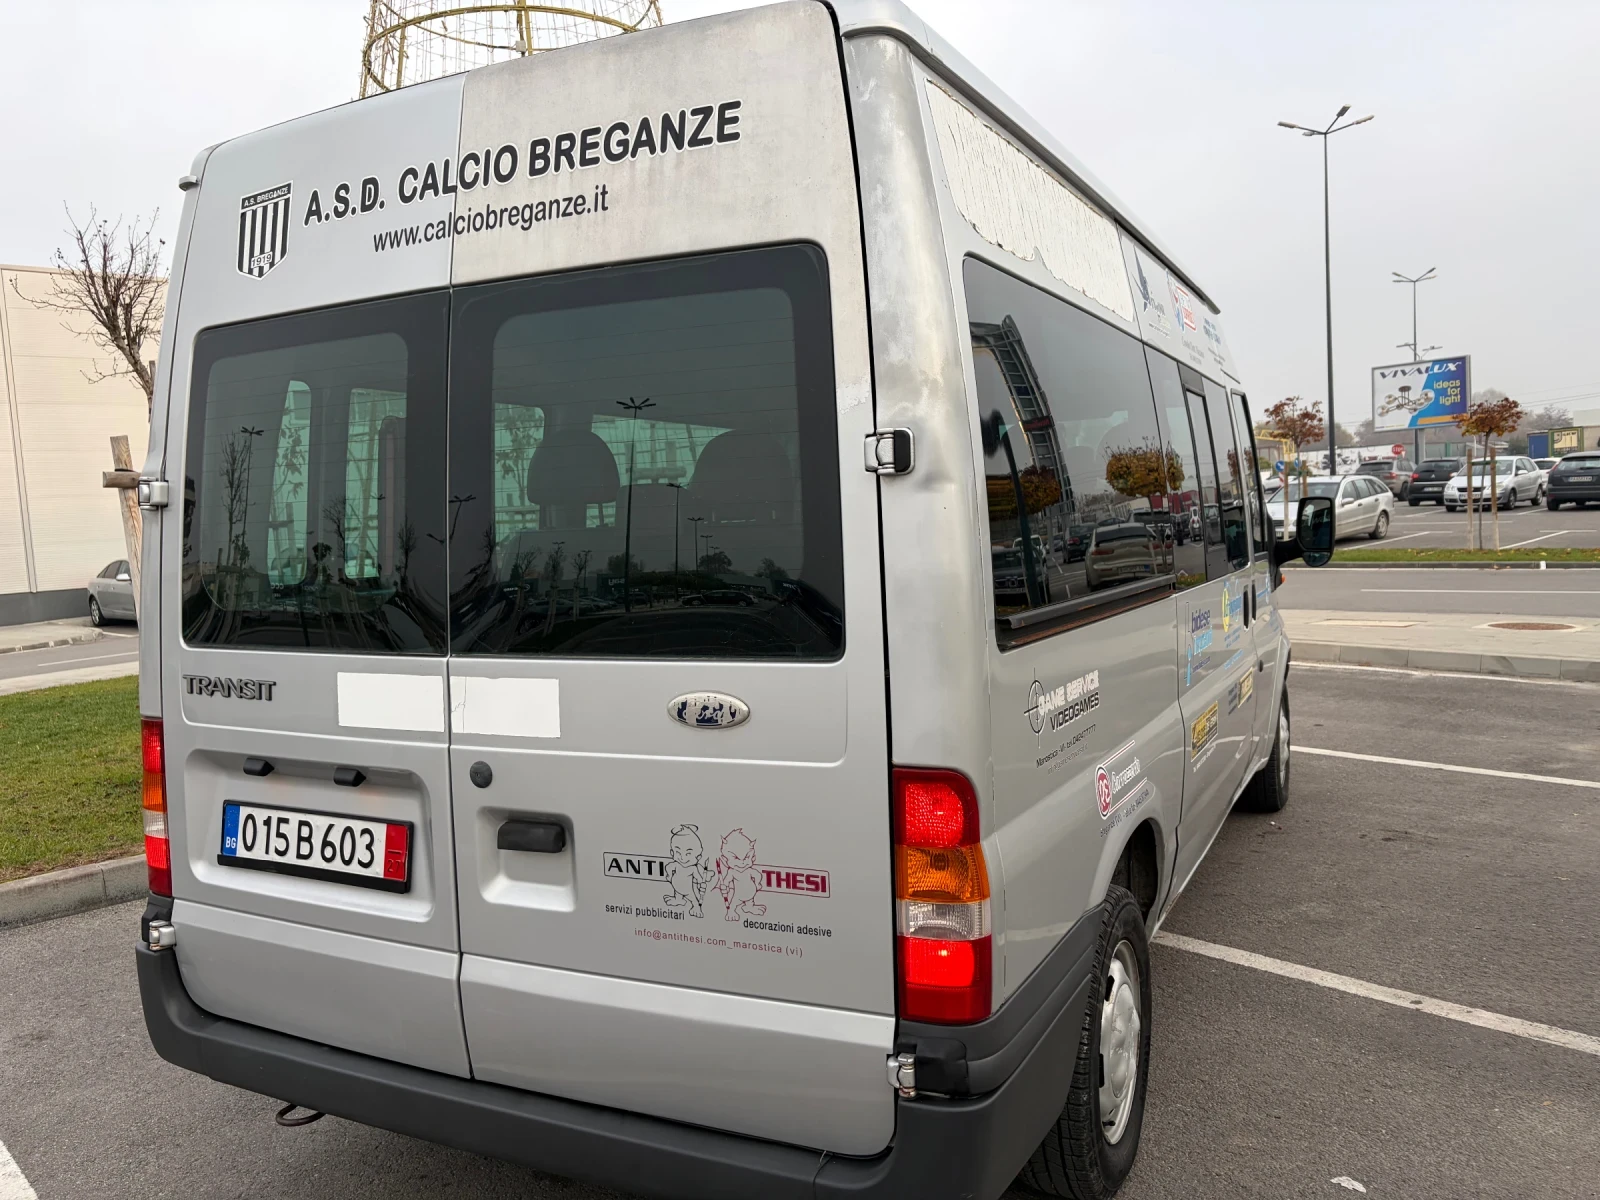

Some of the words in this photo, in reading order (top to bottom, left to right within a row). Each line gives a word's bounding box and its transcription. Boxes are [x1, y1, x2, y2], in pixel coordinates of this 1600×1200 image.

[303, 175, 386, 227] A.S.D.
[398, 144, 520, 205] CALCIO
[528, 99, 744, 178] BREGANZE
[244, 197, 256, 207] A.S.
[257, 186, 289, 203] BREGANZE
[373, 184, 609, 252] www.calciobreganze.it
[251, 253, 272, 267] 1919
[1379, 361, 1460, 380] VIVALUX
[1433, 379, 1461, 389] ideas
[1447, 387, 1461, 396] for
[1439, 394, 1462, 406] light
[182, 674, 277, 701] TRANSIT
[1049, 692, 1100, 732] VIDEOGAMES
[225, 835, 237, 849] BG
[607, 857, 665, 877] ANTI
[761, 869, 828, 894] THESI
[605, 903, 633, 916] servizi
[635, 905, 686, 921] pubblicitari
[743, 918, 794, 934] decorazioni
[796, 924, 832, 938] adesive
[785, 945, 804, 958] (vi)
